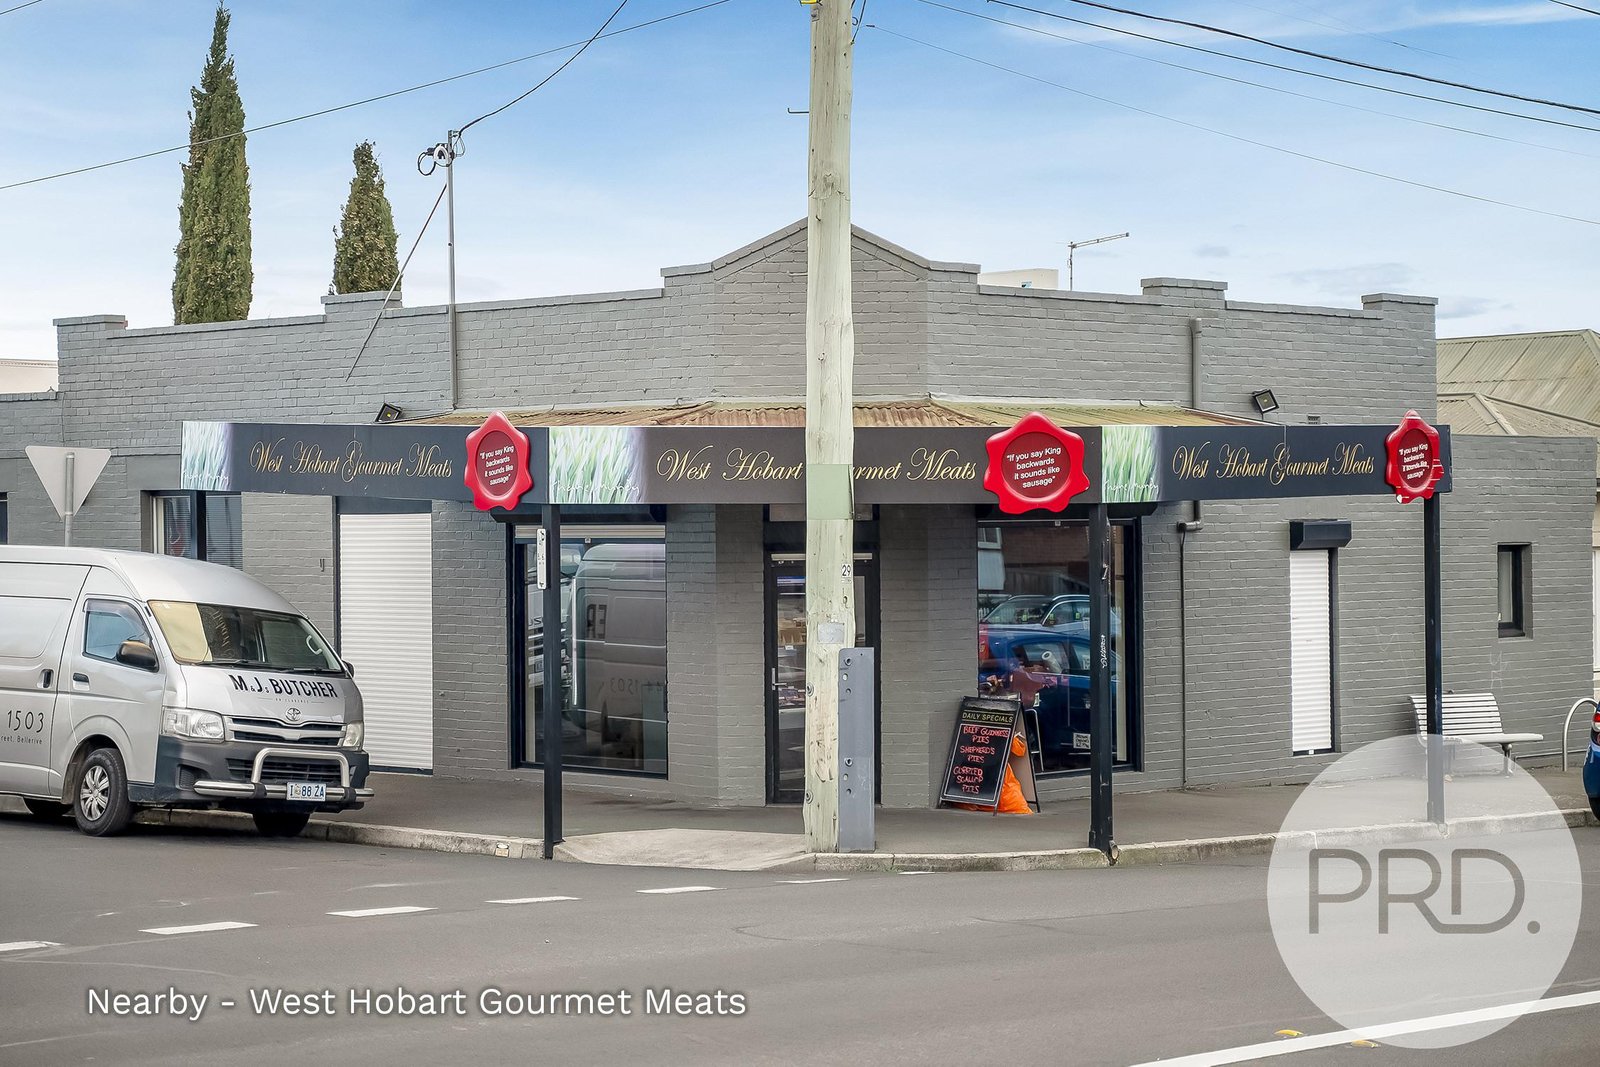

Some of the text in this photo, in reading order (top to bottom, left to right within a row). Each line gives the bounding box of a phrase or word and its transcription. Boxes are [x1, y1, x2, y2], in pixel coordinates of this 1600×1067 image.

[1016, 453, 1029, 462] you
[1031, 450, 1043, 458] say
[1045, 447, 1061, 455] King
[251, 438, 453, 483] West Hobart Gourmet Meats
[657, 445, 714, 482] West
[723, 448, 803, 481] Hobart
[907, 448, 976, 481] Meats
[1017, 458, 1055, 470] backwards
[1173, 442, 1374, 486] West Hobart Gourmet Meats
[1020, 469, 1046, 479] sounds
[1048, 466, 1060, 474] like
[842, 565, 851, 576] 29
[269, 679, 338, 698] BUTCHER
[8, 710, 44, 733] 1503
[982, 714, 1014, 723] SPECIALS
[963, 726, 979, 734] BEEF
[17, 736, 42, 744] Bellerive
[972, 736, 990, 744] PIES
[967, 755, 985, 763] PIES
[953, 766, 983, 776] CURRIED
[962, 785, 980, 794] PIES
